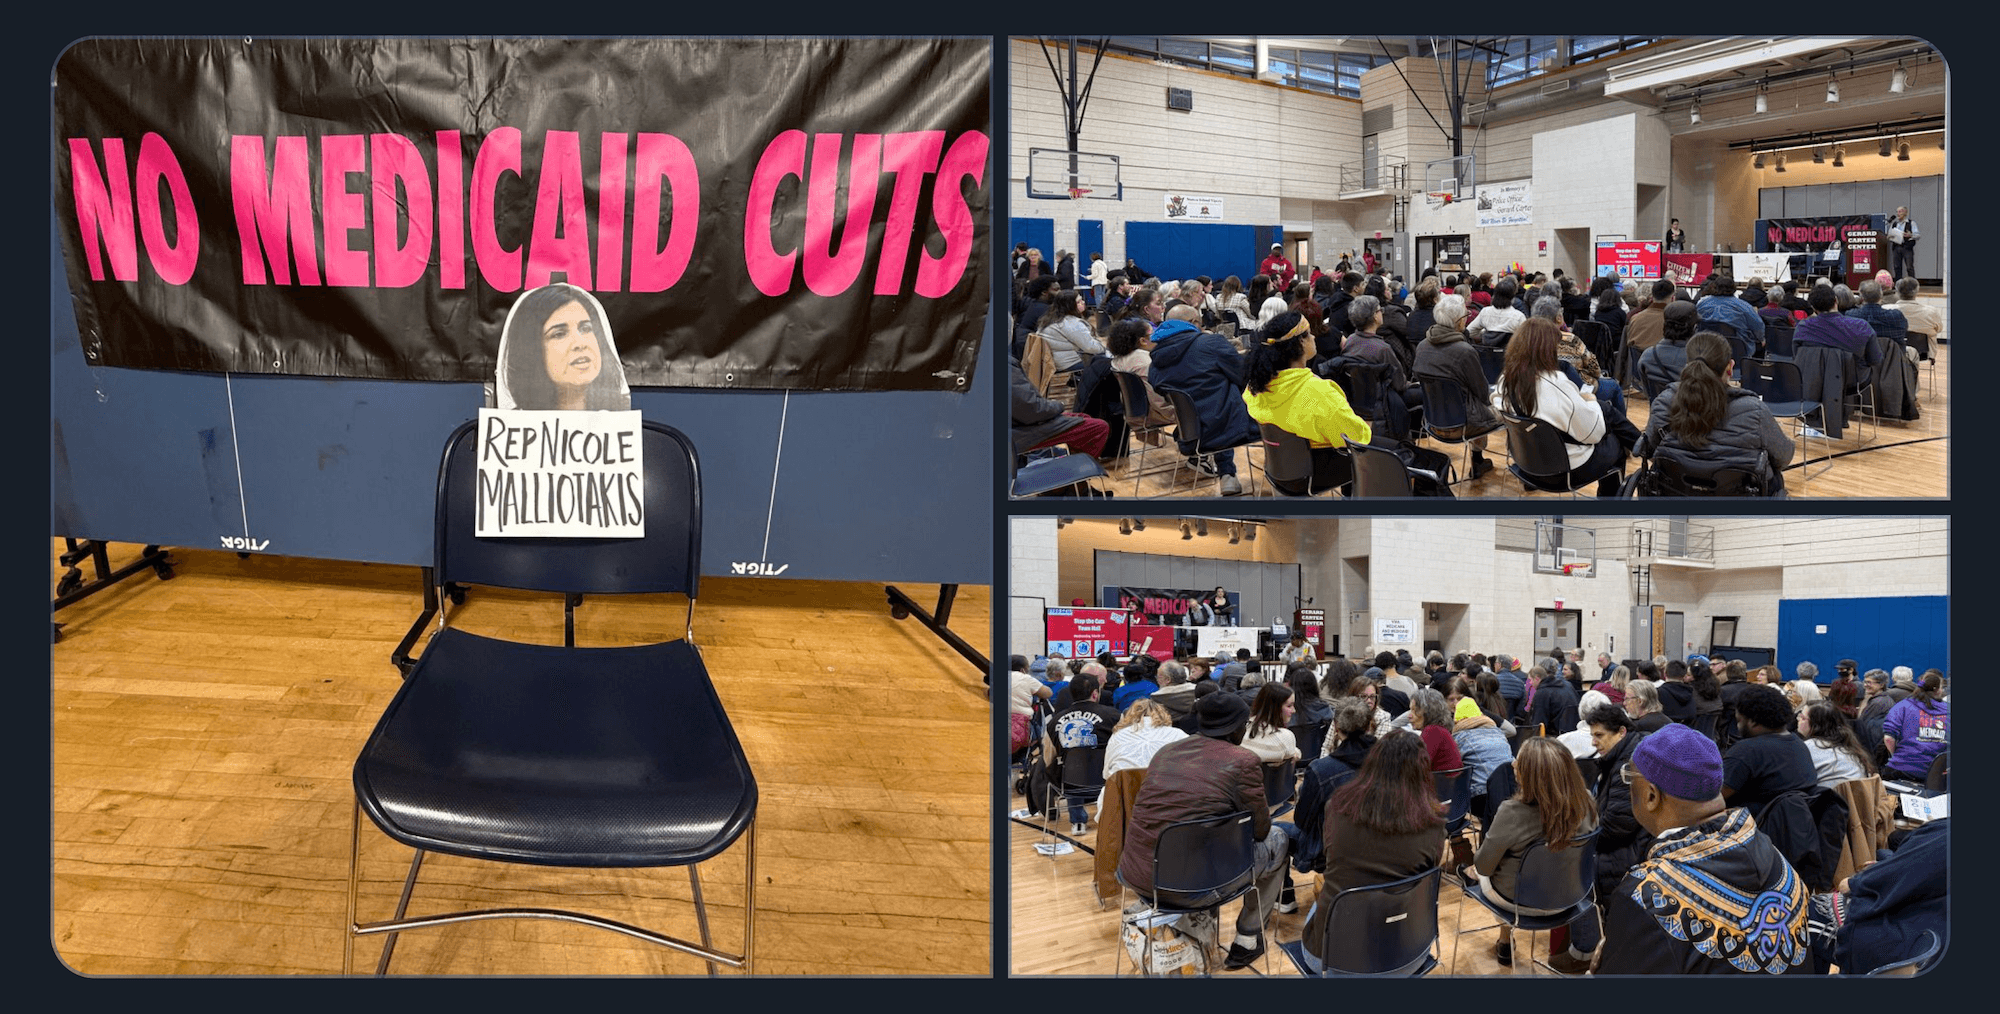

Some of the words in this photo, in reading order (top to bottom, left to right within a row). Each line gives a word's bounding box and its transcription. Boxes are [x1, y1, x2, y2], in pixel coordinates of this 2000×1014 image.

[67, 131, 200, 286] NO
[230, 126, 700, 293] MEDICAID
[744, 129, 990, 298] CUTS
[1497, 204, 1515, 213] Gerard
[1515, 204, 1532, 212] Carter
[1768, 227, 1783, 243] NO
[1786, 225, 1837, 243] MEDICAID
[1667, 261, 1690, 274] CITIZEN
[483, 416, 537, 467] REP
[540, 418, 634, 468] NICOLE
[478, 468, 642, 532] MALLIOTAKIS
[220, 535, 270, 551] STIGA
[730, 561, 789, 576] STIGA
[1144, 597, 1190, 615] MEDICA
[1055, 711, 1103, 732] DETROIT
[1919, 727, 1946, 740] MEDICAID
